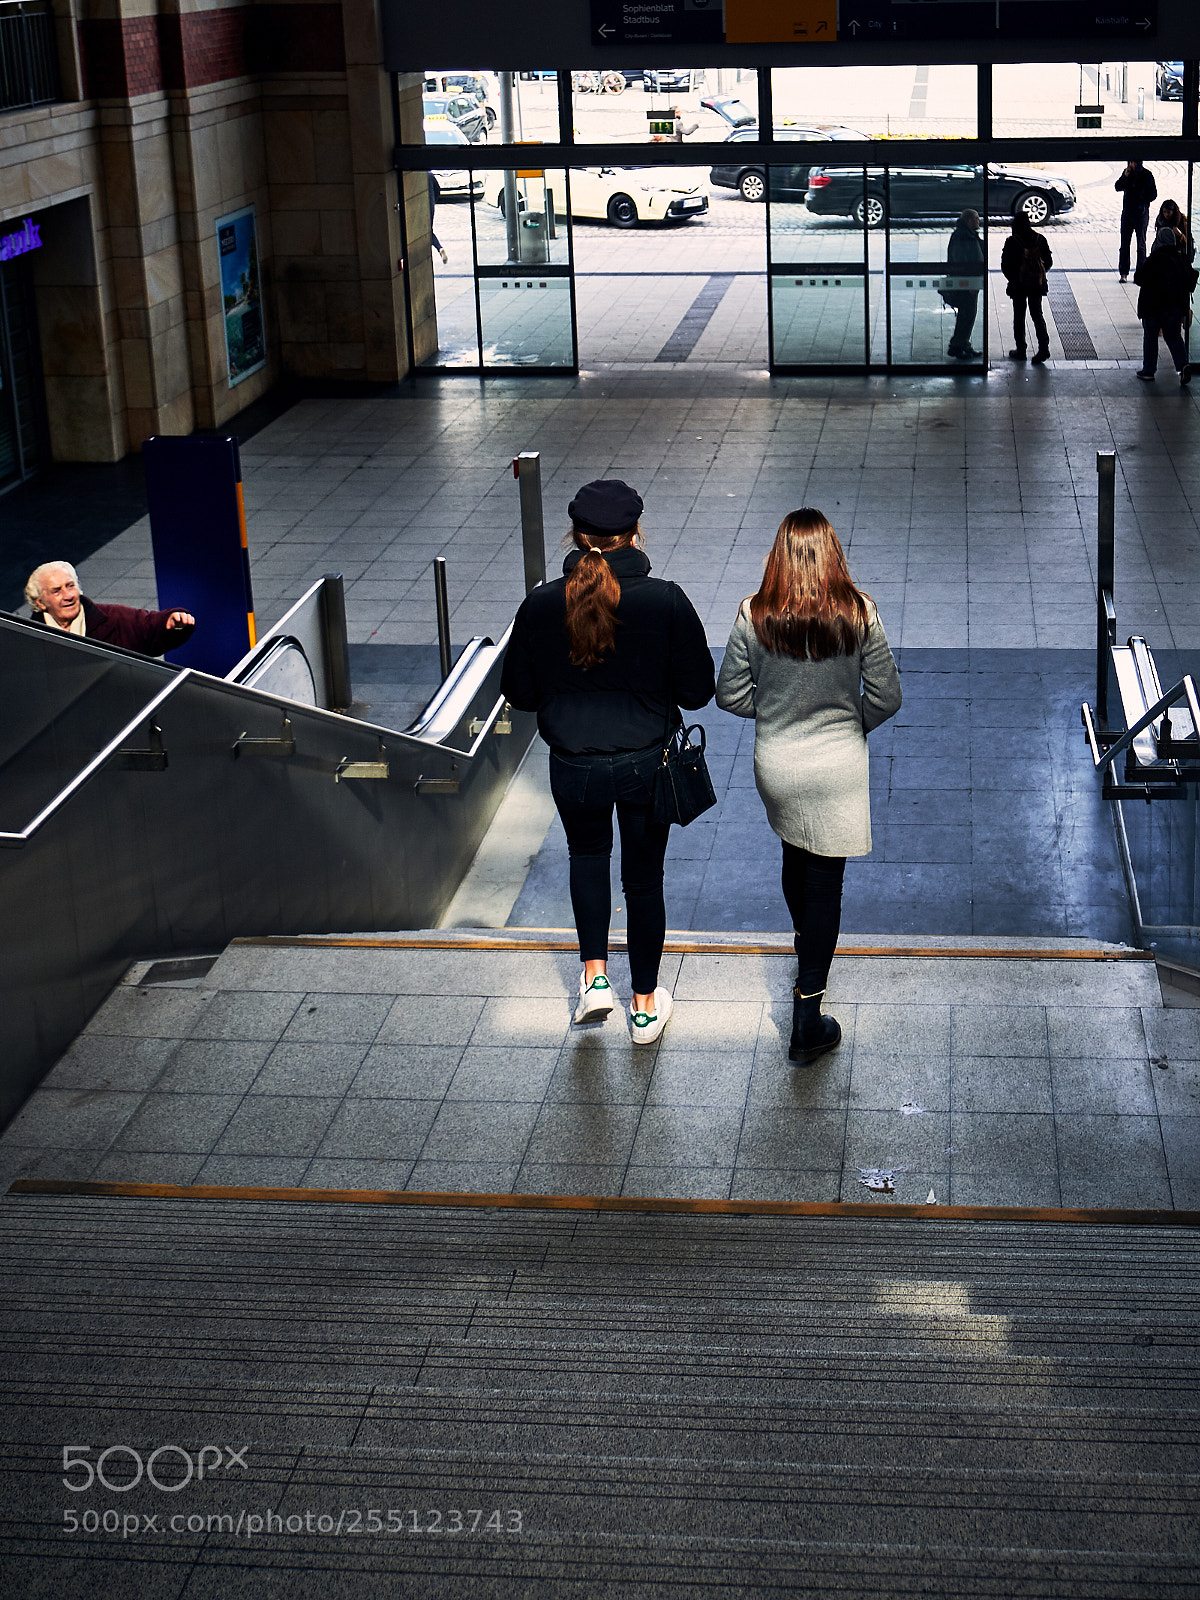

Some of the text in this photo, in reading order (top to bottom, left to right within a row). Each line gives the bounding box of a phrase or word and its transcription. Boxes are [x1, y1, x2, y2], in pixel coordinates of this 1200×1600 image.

[622, 4, 675, 14] Sophienblatt
[623, 15, 660, 24] Stadtbus
[867, 20, 883, 30] City
[0, 218, 43, 261] ank
